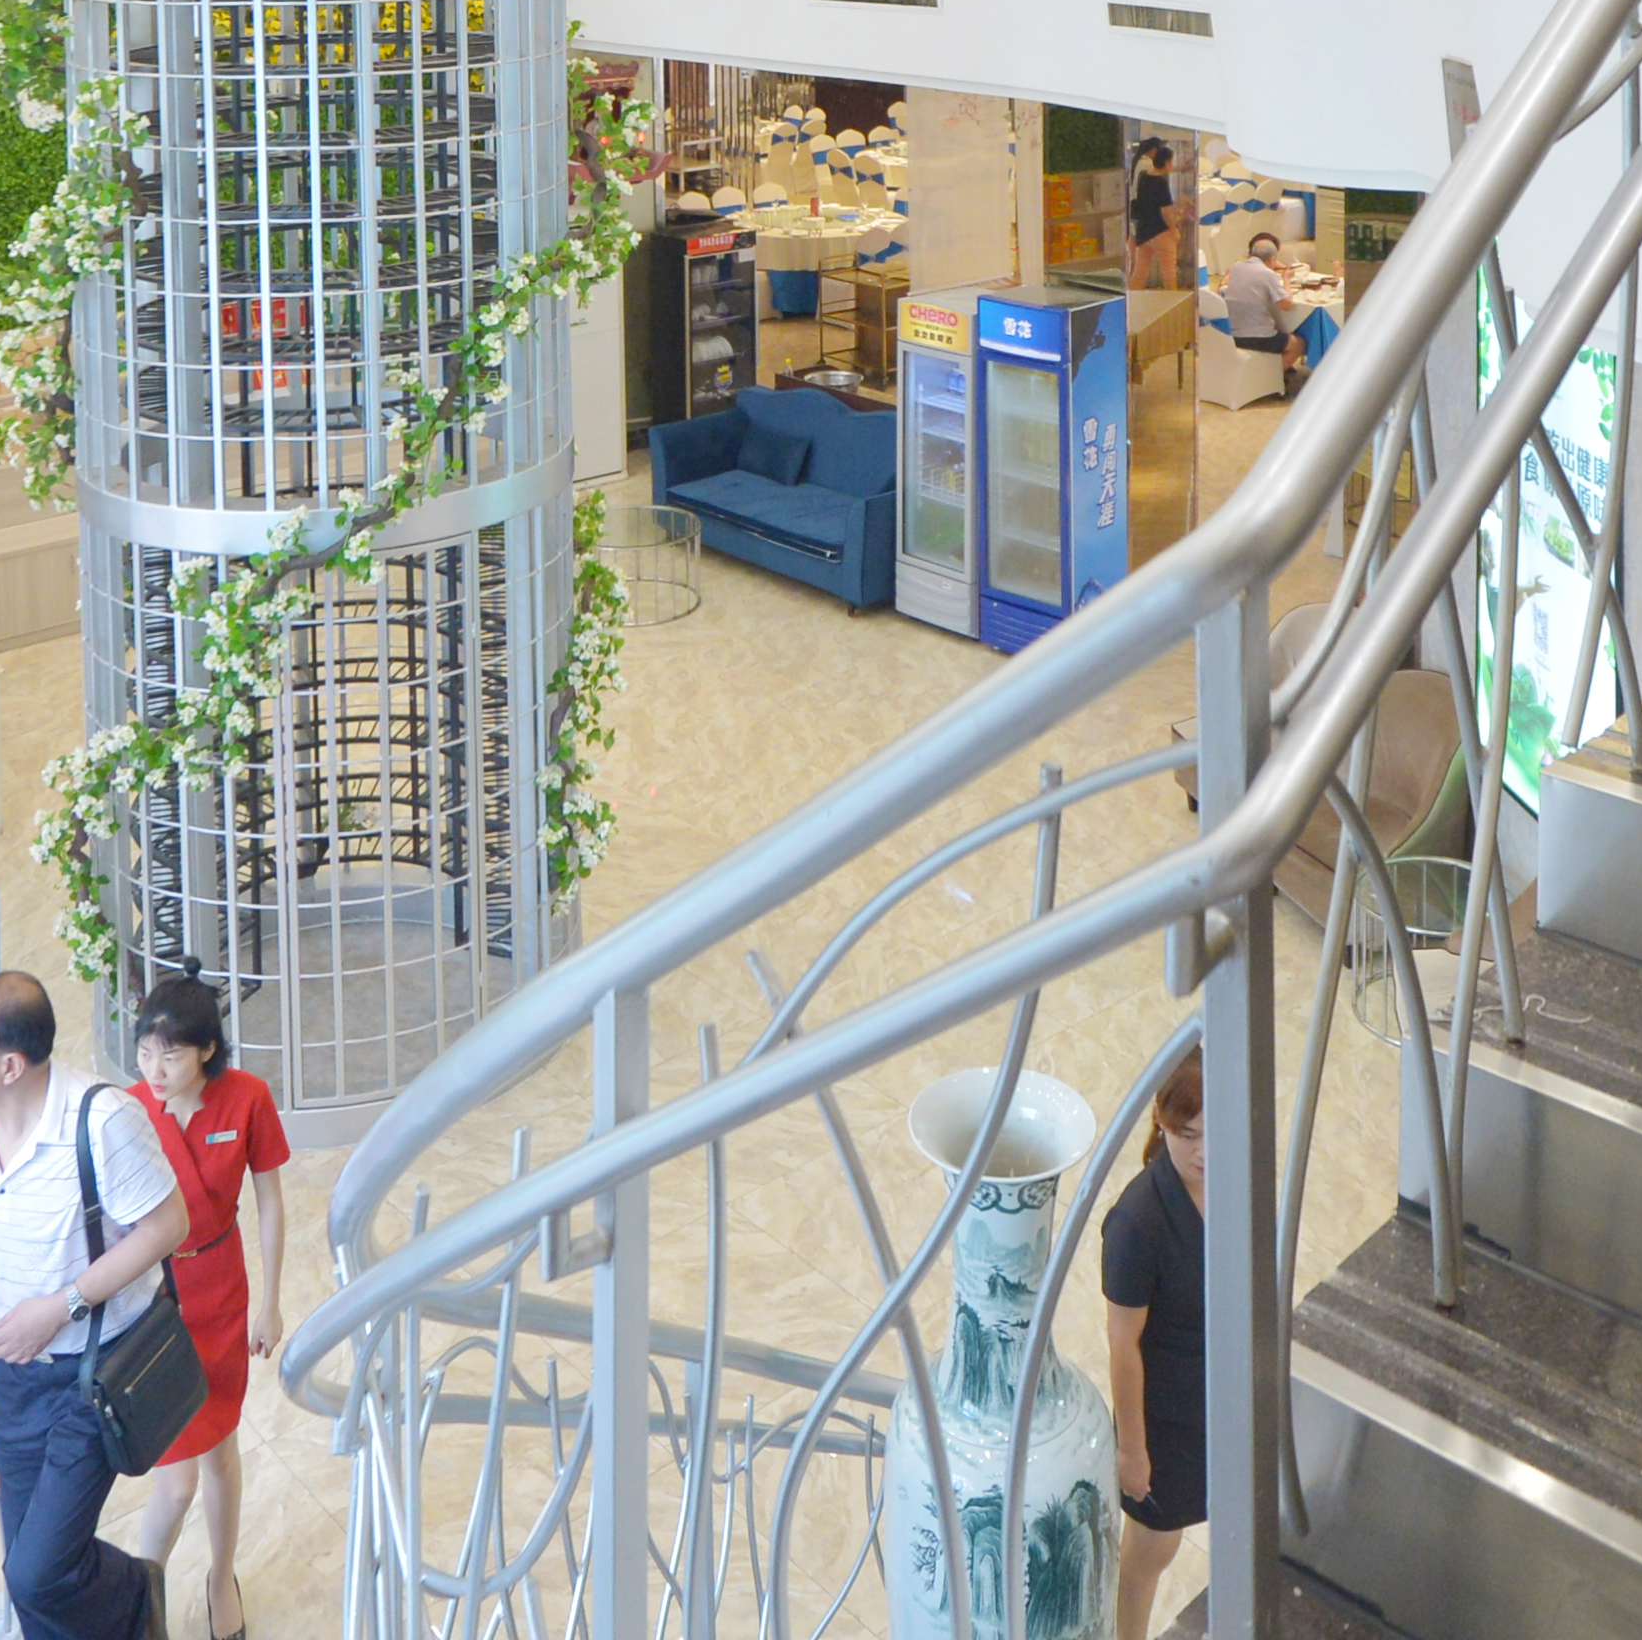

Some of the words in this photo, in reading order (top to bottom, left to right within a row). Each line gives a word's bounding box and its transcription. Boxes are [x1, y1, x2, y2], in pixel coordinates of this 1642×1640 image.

[1003, 317, 1033, 339] 雪花
[1082, 416, 1099, 471] 雪花
[1097, 422, 1117, 529] 勇闯天涯
